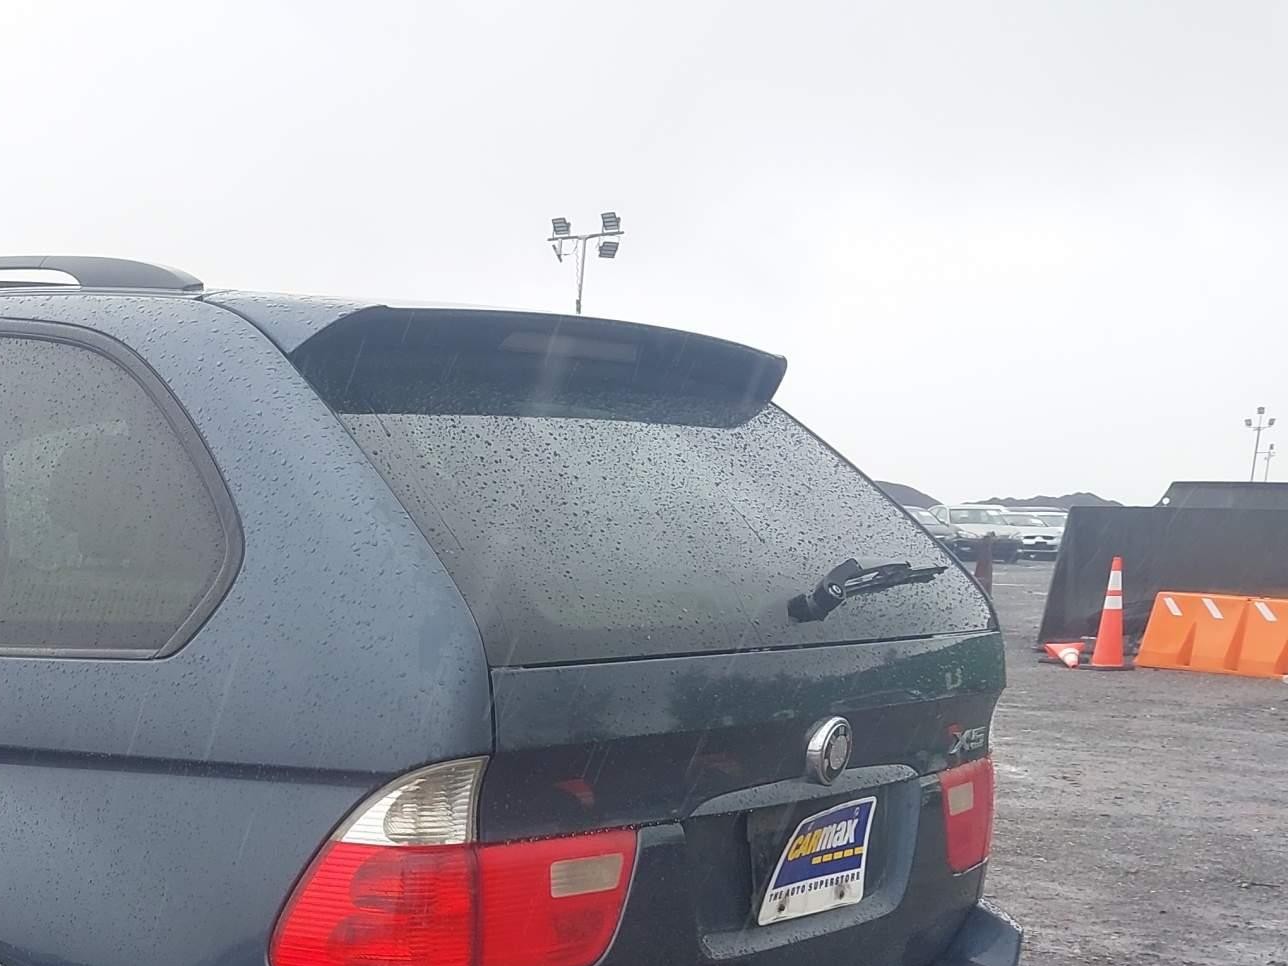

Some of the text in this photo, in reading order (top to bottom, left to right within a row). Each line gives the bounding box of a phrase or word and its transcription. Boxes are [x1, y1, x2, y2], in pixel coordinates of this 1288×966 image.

[949, 726, 986, 754] X5
[769, 871, 860, 902] THE AUTO SUPERSTORE
